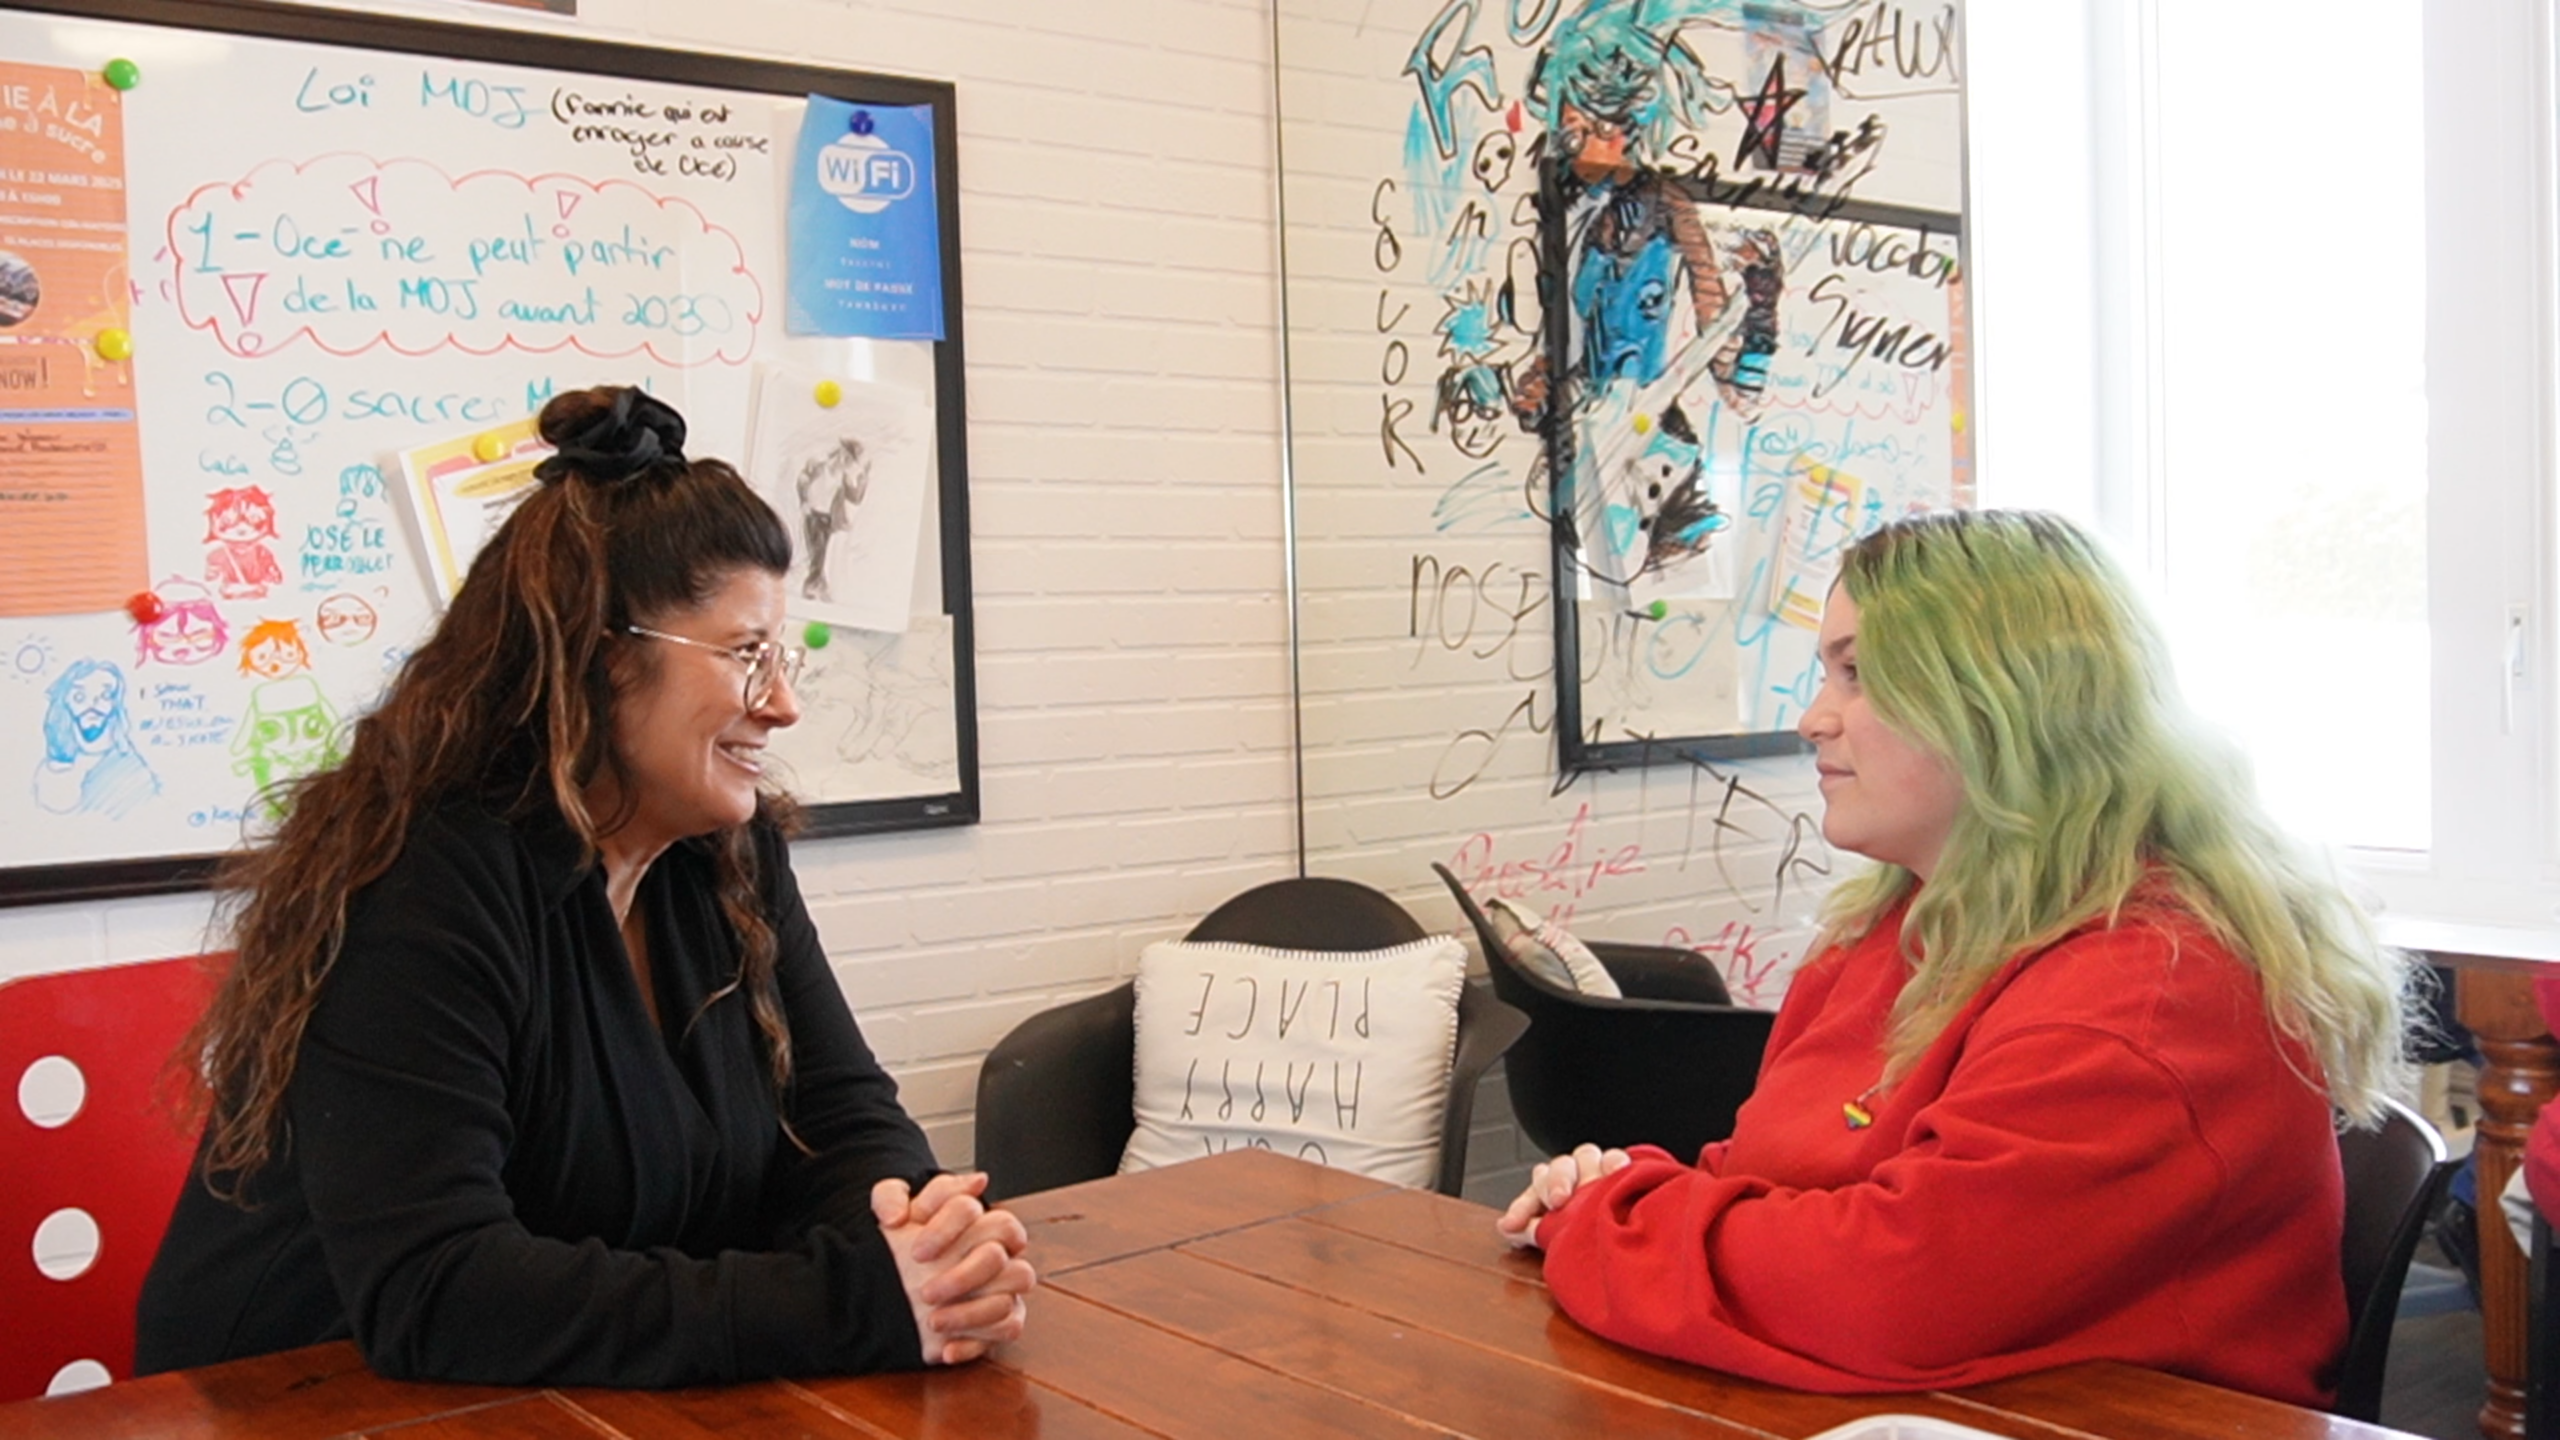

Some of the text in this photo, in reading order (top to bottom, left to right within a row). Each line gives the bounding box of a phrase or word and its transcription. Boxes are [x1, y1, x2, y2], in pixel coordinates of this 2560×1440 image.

[65, 101, 104, 138] LA
[296, 67, 543, 128] Loi MOJ
[663, 101, 692, 124] qui
[45, 123, 107, 165] sucre
[381, 239, 434, 263] ne
[469, 212, 546, 275] peut
[564, 225, 676, 275] partir
[283, 276, 733, 336] de la MOJ avant 2030
[342, 390, 506, 424] sacrer
[363, 527, 386, 550] LE
[1184, 972, 1370, 1040] PLACE
[1175, 1057, 1362, 1130] HAPPY
